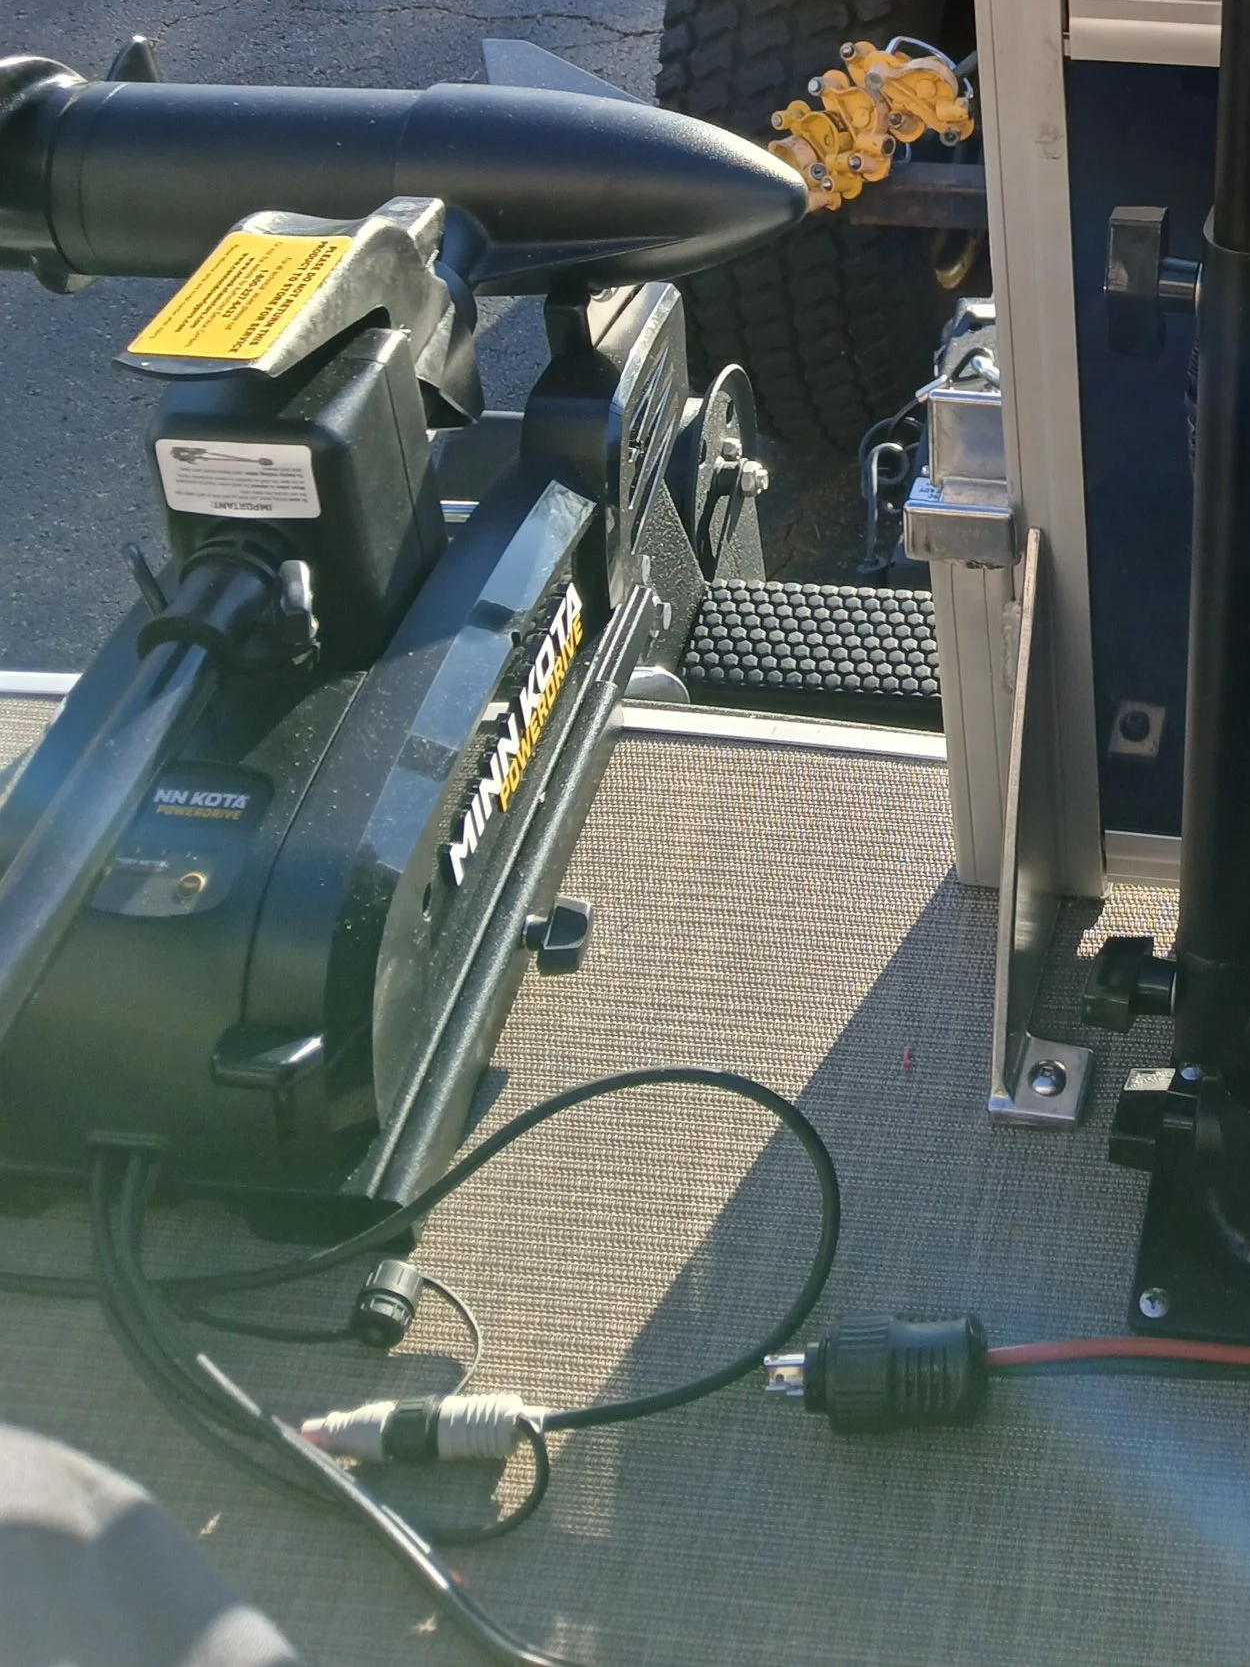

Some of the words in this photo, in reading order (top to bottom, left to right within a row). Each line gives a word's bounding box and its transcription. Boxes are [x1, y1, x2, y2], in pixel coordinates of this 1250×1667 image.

[297, 241, 328, 270] PRODUCT
[310, 246, 337, 270] PLEASE
[287, 272, 302, 281] TO
[301, 272, 316, 281] DO
[268, 283, 293, 304] STORE
[288, 283, 306, 297] NOT
[254, 307, 273, 320] FOR
[263, 298, 294, 327] RETURN
[227, 323, 260, 352] SERVICE
[248, 329, 269, 345] THIS
[500, 612, 584, 814] POWERDRIVE
[450, 712, 521, 886] MINN
[519, 582, 583, 728] KOTA
[153, 789, 189, 805] NN
[189, 791, 246, 810] KOTA
